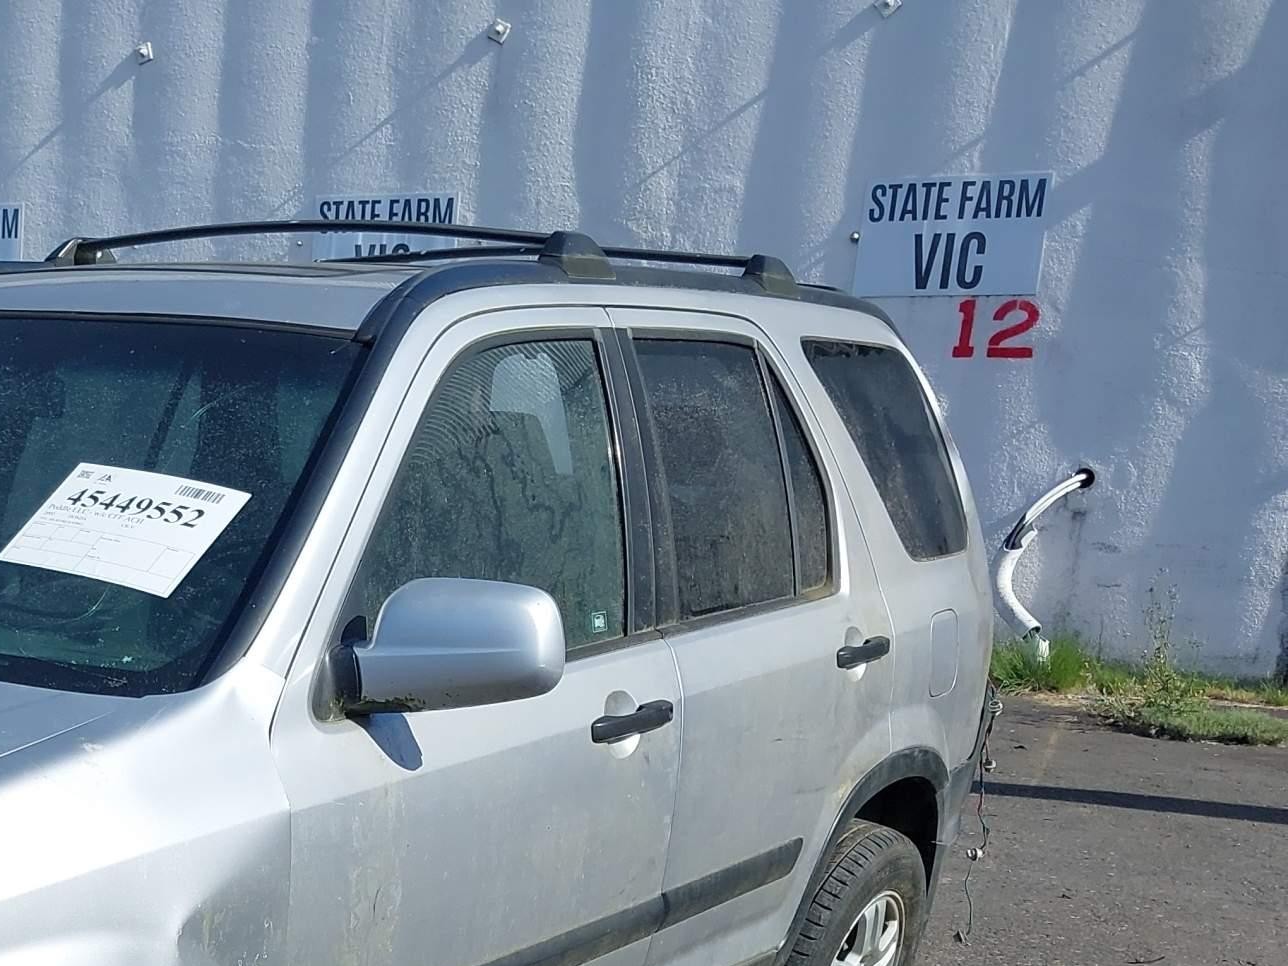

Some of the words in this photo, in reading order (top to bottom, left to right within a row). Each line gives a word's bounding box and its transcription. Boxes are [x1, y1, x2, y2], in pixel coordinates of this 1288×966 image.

[319, 200, 382, 234] STATE
[388, 197, 455, 224] FARM
[868, 182, 952, 223] STATE
[957, 178, 1047, 220] FARM
[914, 231, 987, 290] VIC
[952, 299, 1040, 358] 12
[67, 488, 205, 529] 45449552
